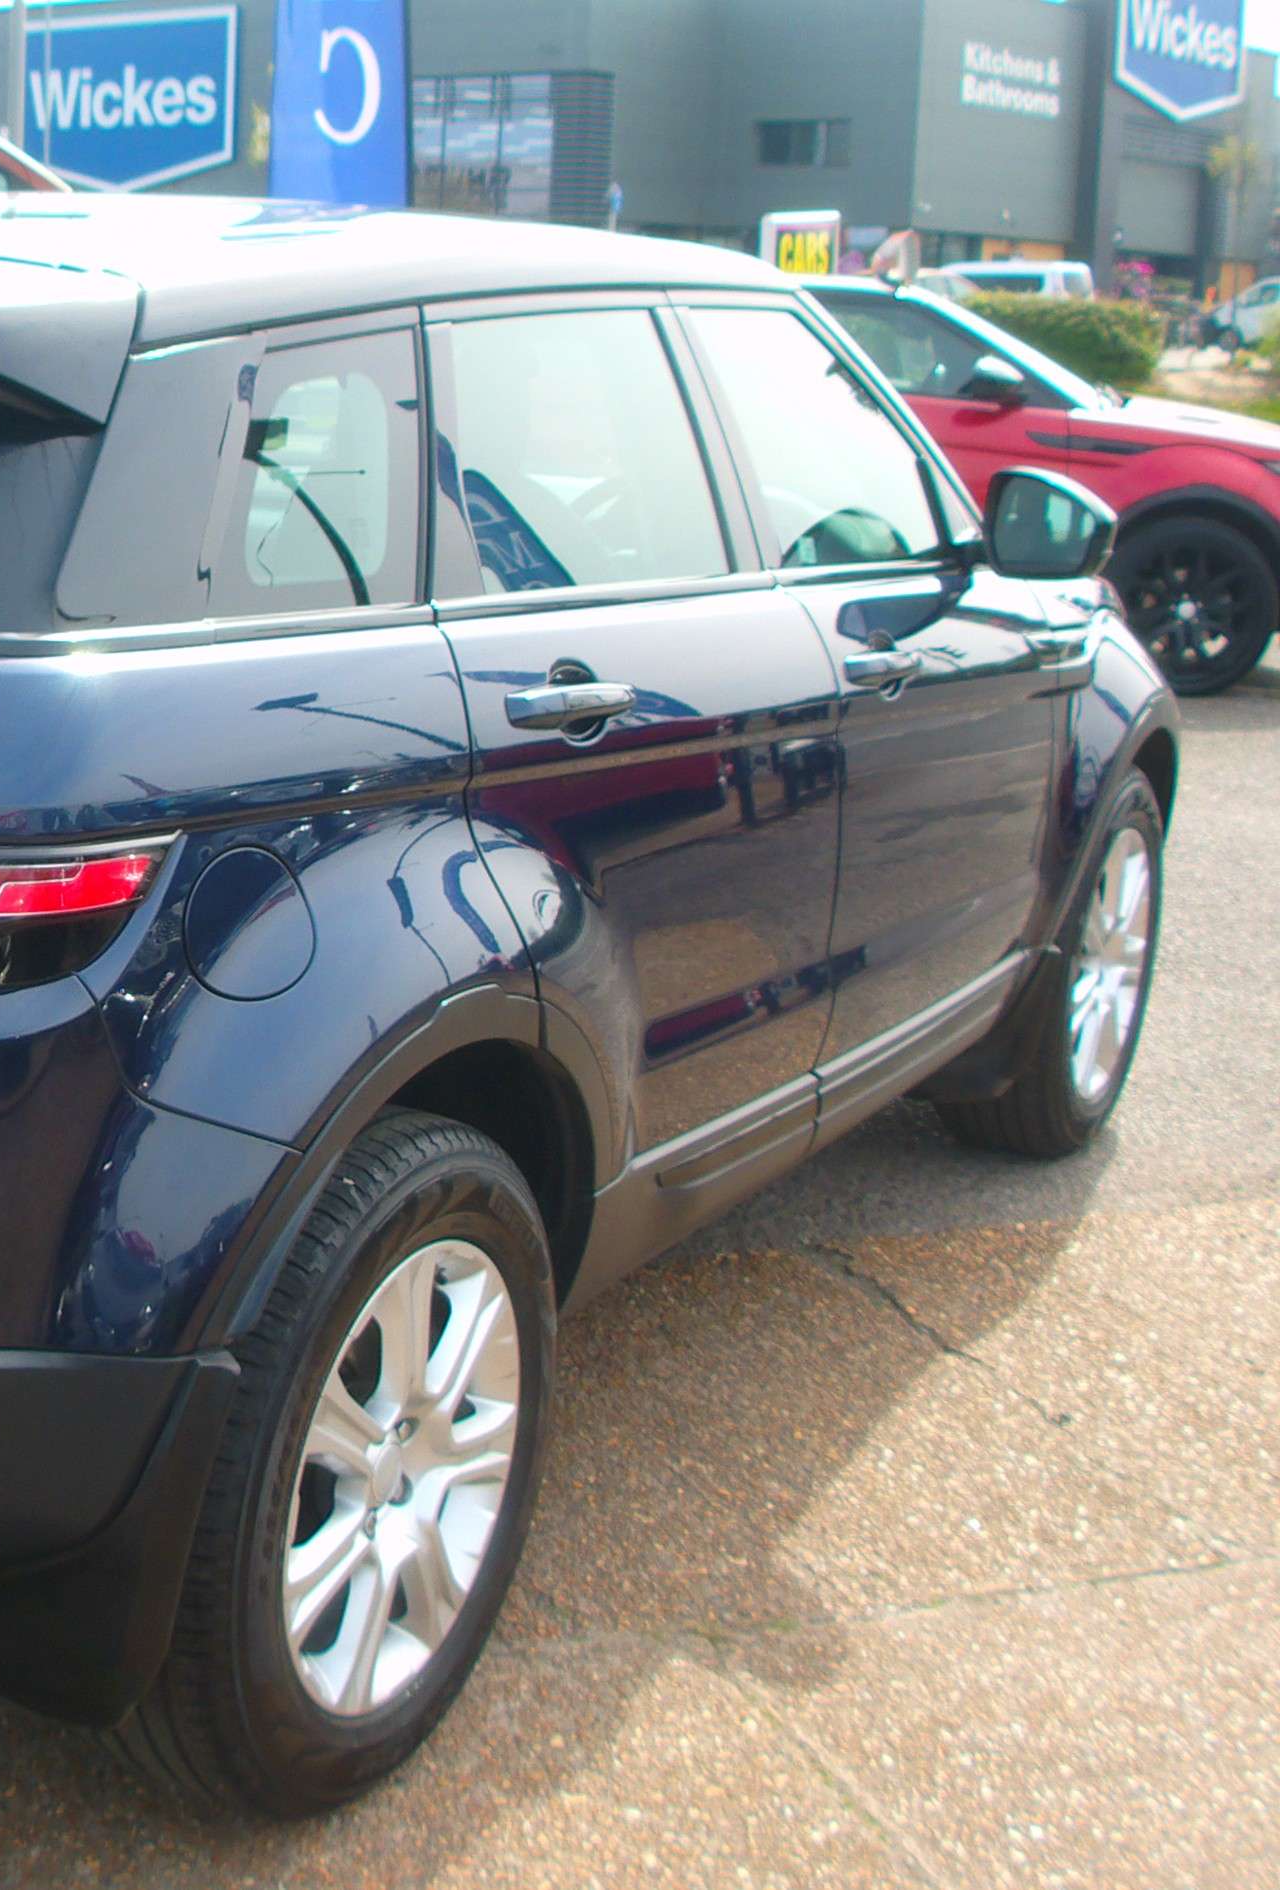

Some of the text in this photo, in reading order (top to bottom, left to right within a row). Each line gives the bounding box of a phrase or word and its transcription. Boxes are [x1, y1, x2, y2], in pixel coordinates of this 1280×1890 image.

[1129, 0, 1238, 70] Wickes
[963, 41, 1060, 87] Kitchens &
[29, 64, 217, 130] Wickes
[961, 73, 1060, 119] Bathrooms
[779, 231, 830, 275] CARS
